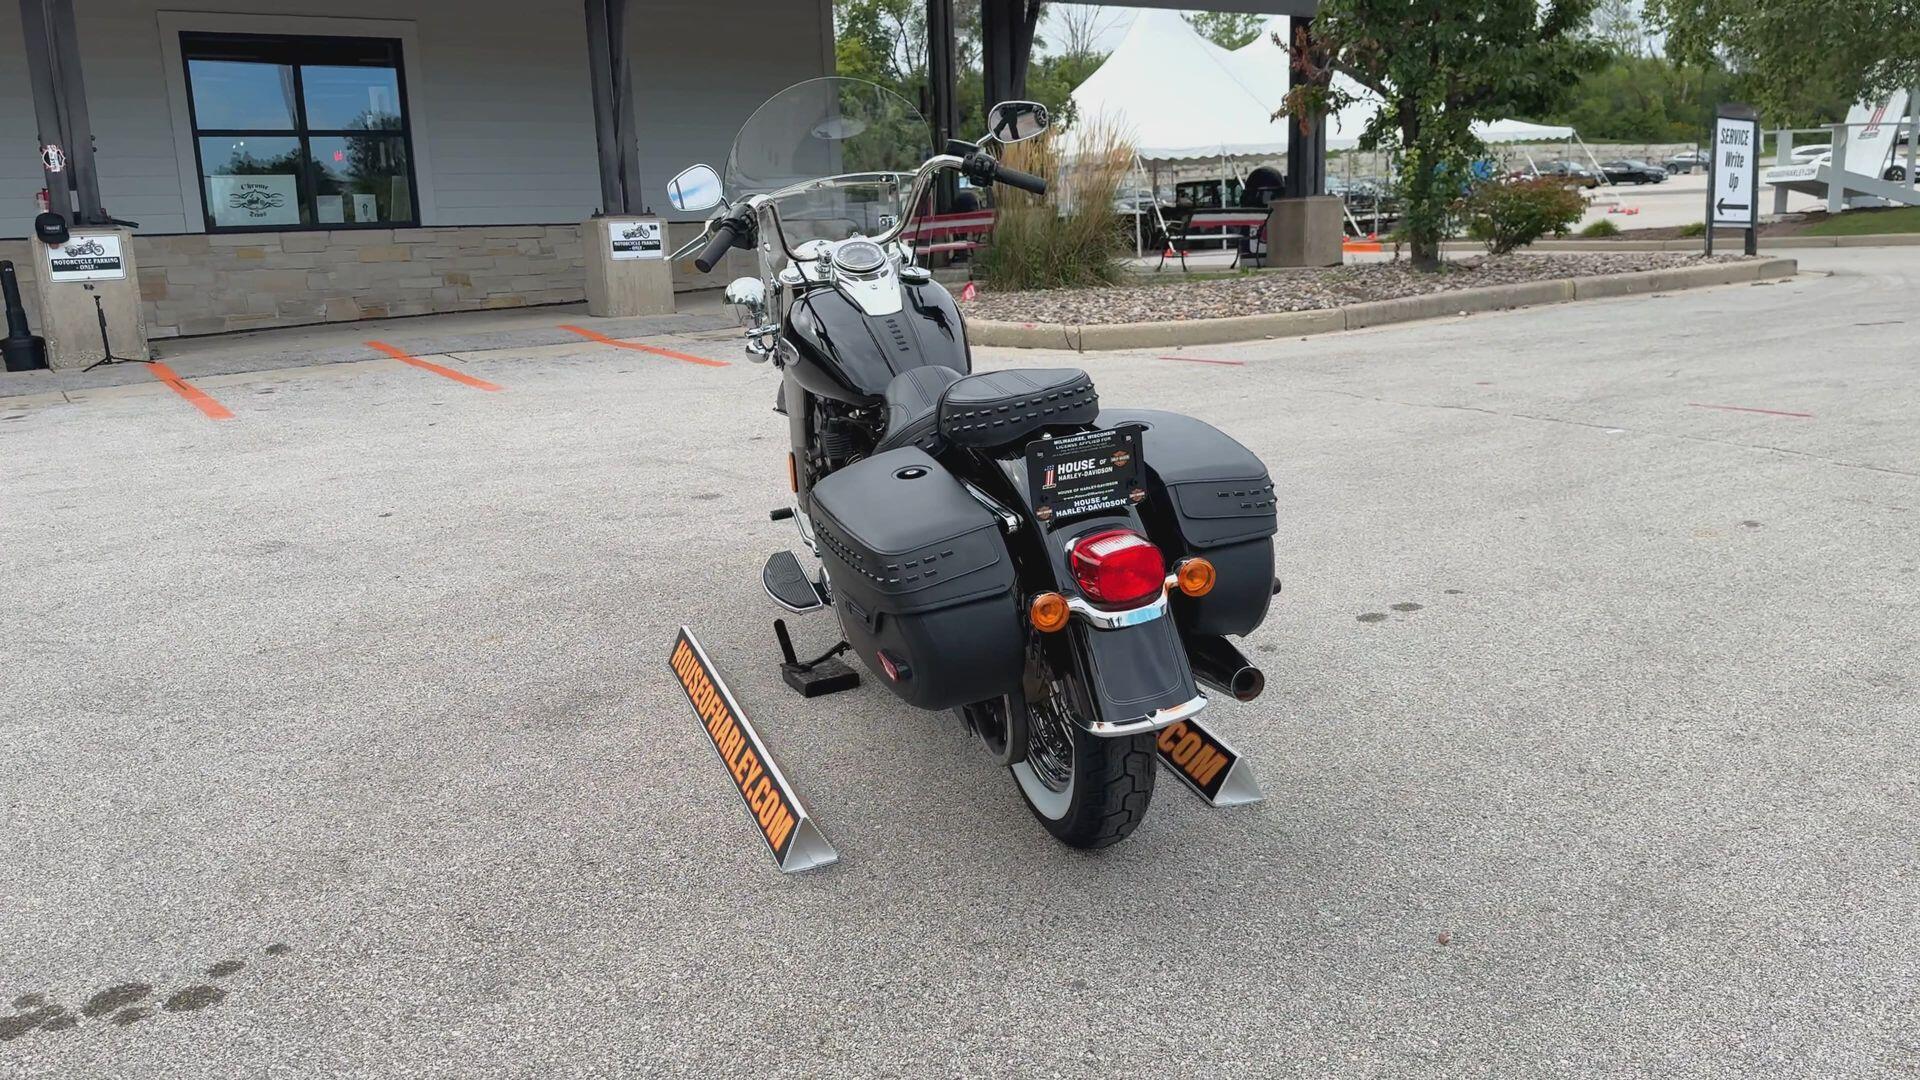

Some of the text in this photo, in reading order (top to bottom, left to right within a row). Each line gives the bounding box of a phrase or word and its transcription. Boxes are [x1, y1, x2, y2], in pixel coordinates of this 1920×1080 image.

[1720, 128, 1750, 146] SERVICE
[1724, 151, 1745, 168] Write
[1728, 173, 1739, 192] Up
[1087, 430, 1117, 440] WISCONSIN
[1057, 458, 1096, 475] HOUSE
[1058, 466, 1114, 481] HARLEY-DAVIDSON
[1055, 498, 1127, 517] HARLEY-DAVIDSON
[1074, 496, 1100, 507] HOUSE
[671, 639, 796, 852] HOUSEOFHARLEY.COM
